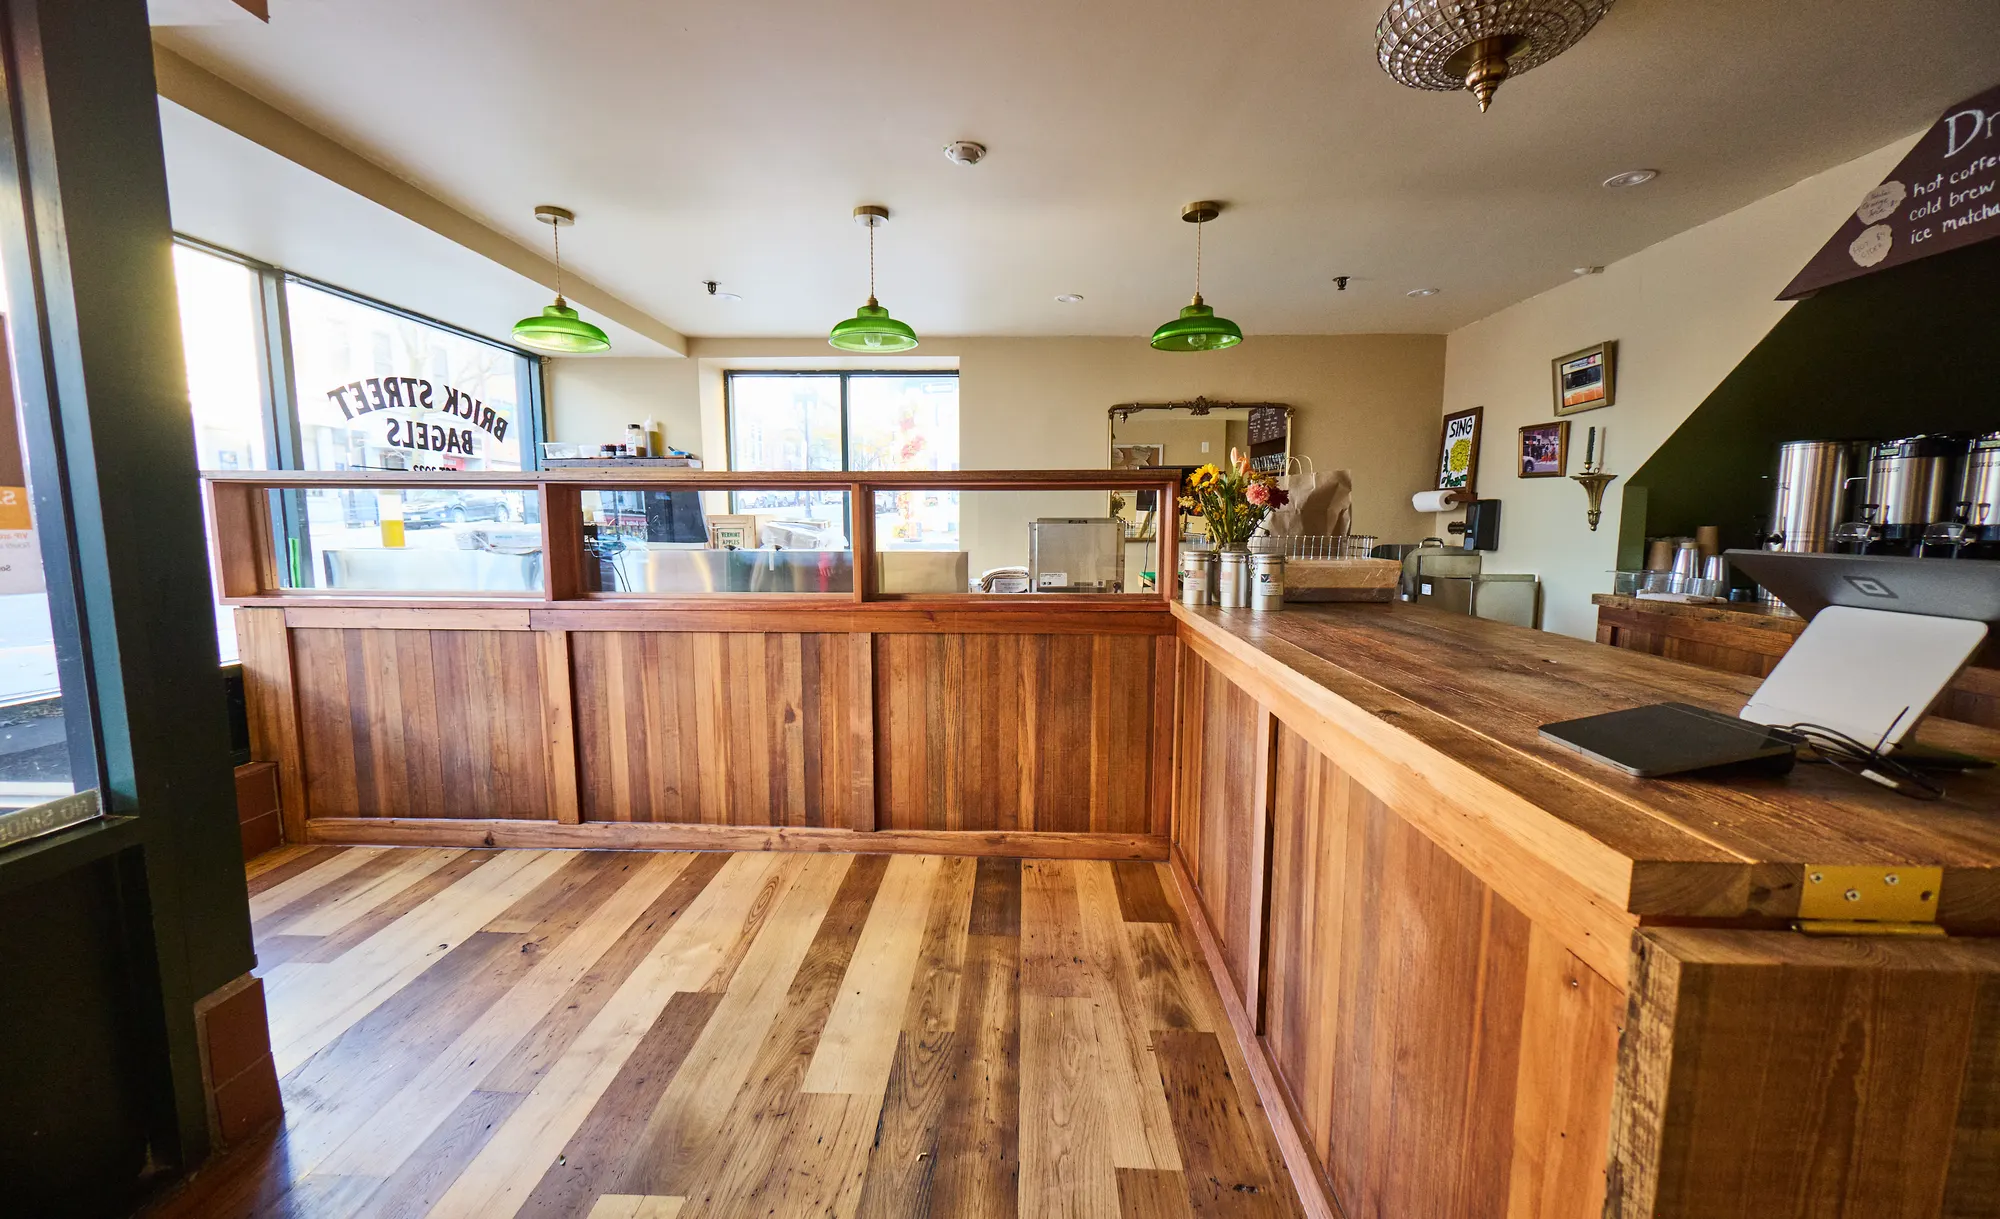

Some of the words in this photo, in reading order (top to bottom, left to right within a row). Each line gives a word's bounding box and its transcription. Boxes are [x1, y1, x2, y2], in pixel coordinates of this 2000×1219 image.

[1912, 173, 1944, 198] hot
[1949, 155, 2000, 184] coffe
[1909, 196, 1942, 222] cold
[1949, 180, 1996, 208] brew
[1910, 227, 1933, 245] ice
[1942, 203, 2000, 233] matcha
[1449, 417, 1473, 438] SING
